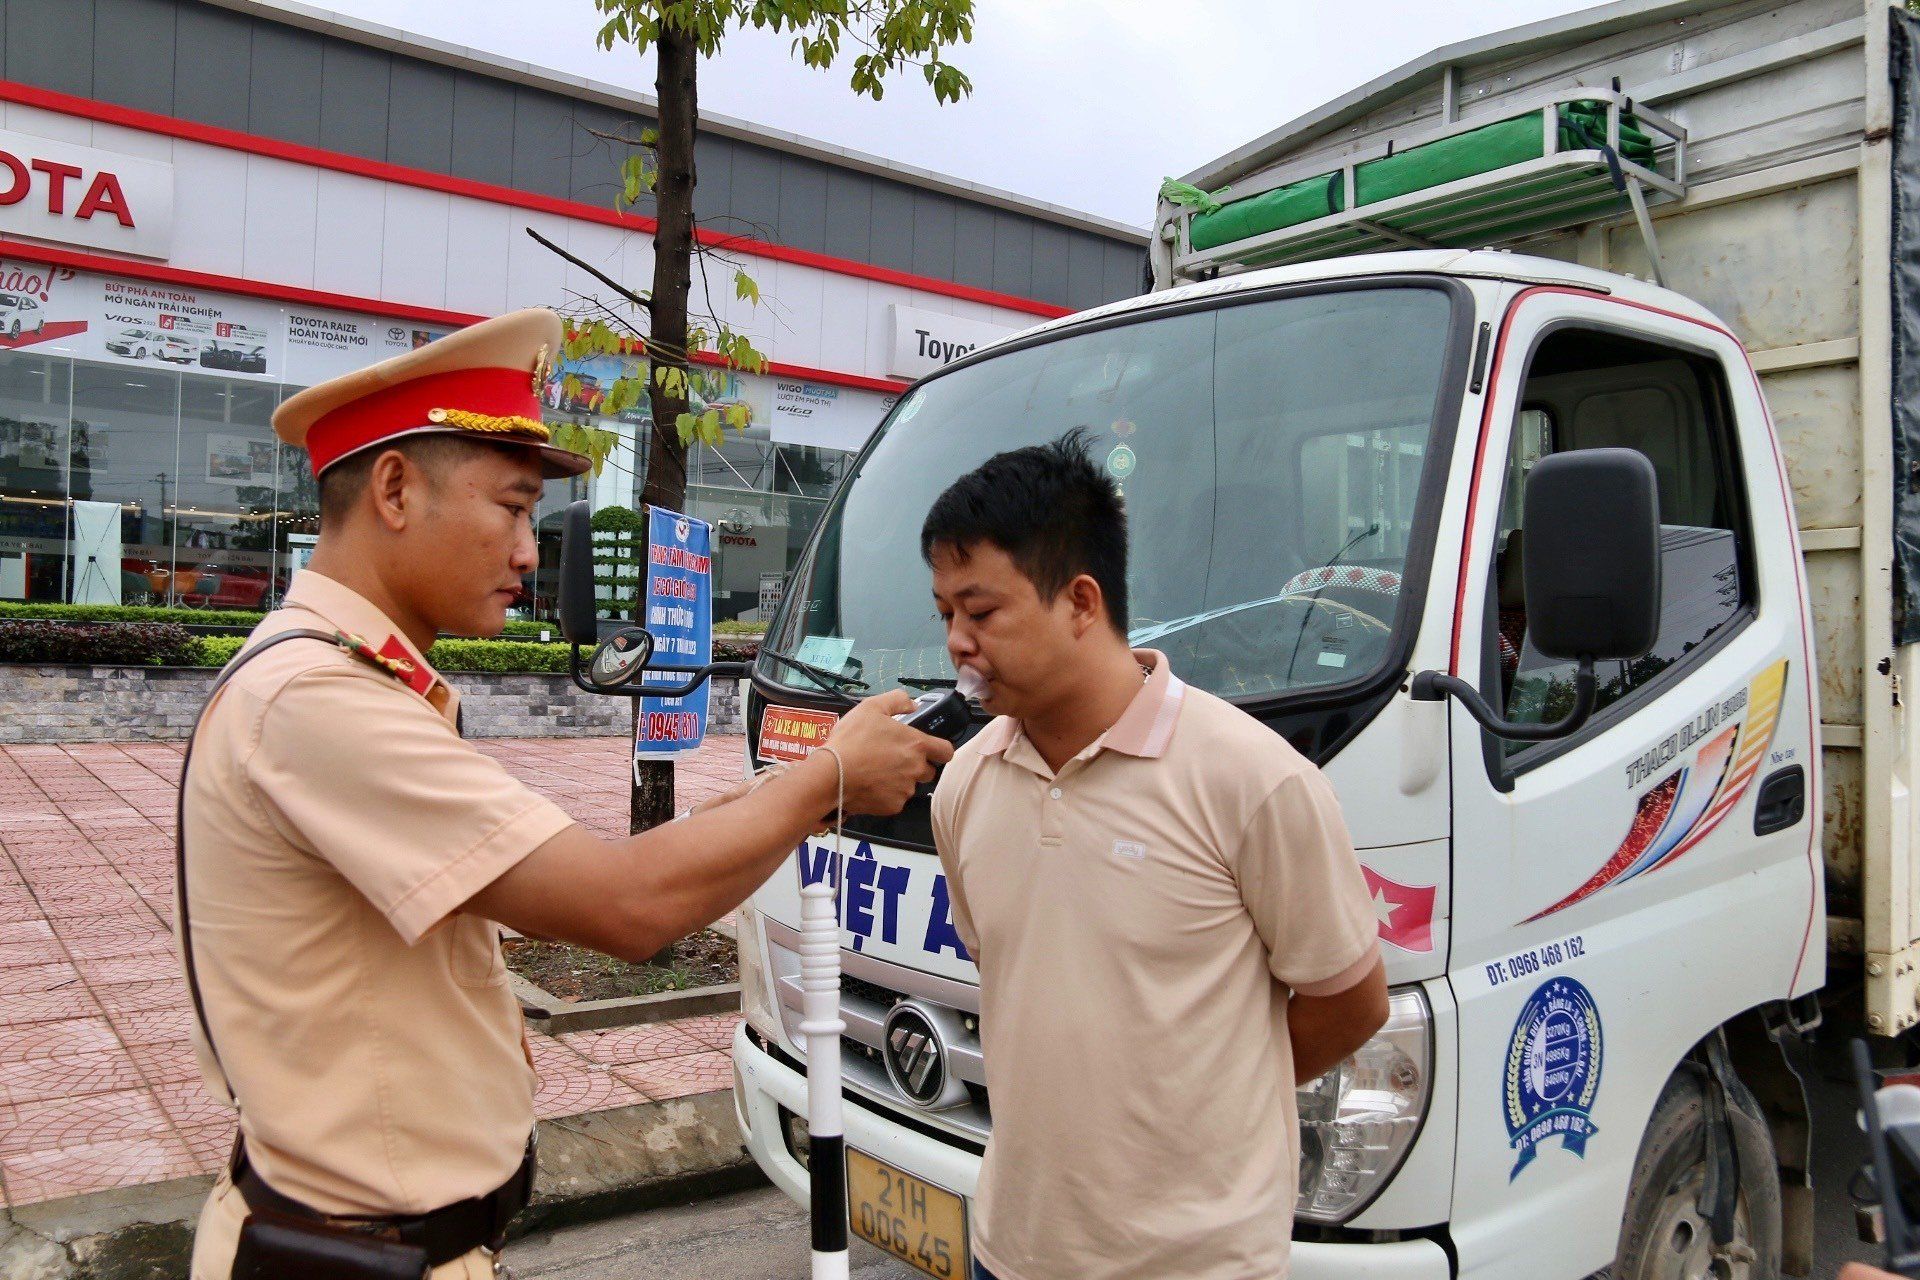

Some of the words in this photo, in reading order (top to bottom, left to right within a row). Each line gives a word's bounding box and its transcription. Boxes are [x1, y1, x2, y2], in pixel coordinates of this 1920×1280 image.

[0, 262, 76, 303] ào!”
[105, 282, 126, 293] BỨT
[128, 286, 148, 297] PHÁ
[151, 290, 166, 299] AN
[168, 292, 196, 304] TOÀN
[105, 313, 143, 325] VIOS
[125, 297, 155, 309] NGÀN
[158, 302, 180, 313] TRẢI
[183, 305, 222, 319] NGHIỆM
[290, 315, 328, 330] TOYOTA
[331, 321, 357, 334] RAIZE
[289, 327, 319, 340] HOÀN
[321, 331, 347, 344] TOÀN
[349, 335, 368, 346] MỚI
[385, 340, 408, 348] TOYOTA
[777, 382, 802, 393] WIGO
[719, 535, 757, 547] TOYOTA
[671, 637, 676, 653] 7
[648, 711, 679, 742] 0945
[774, 716, 784, 735] LÁI
[783, 719, 792, 736] XE
[790, 720, 801, 738] AN
[800, 720, 817, 740] TOÀN
[1625, 732, 1678, 790] THACO
[1680, 702, 1720, 752] OLLIN
[798, 840, 911, 952] VIỆT
[1508, 951, 1540, 979] 0968
[1541, 943, 1562, 967] 468
[1563, 935, 1585, 960] 162
[1553, 1114, 1570, 1131] 468
[1570, 1115, 1585, 1133] 162
[878, 1167, 927, 1225] 21H
[861, 1200, 951, 1278] 006.45
